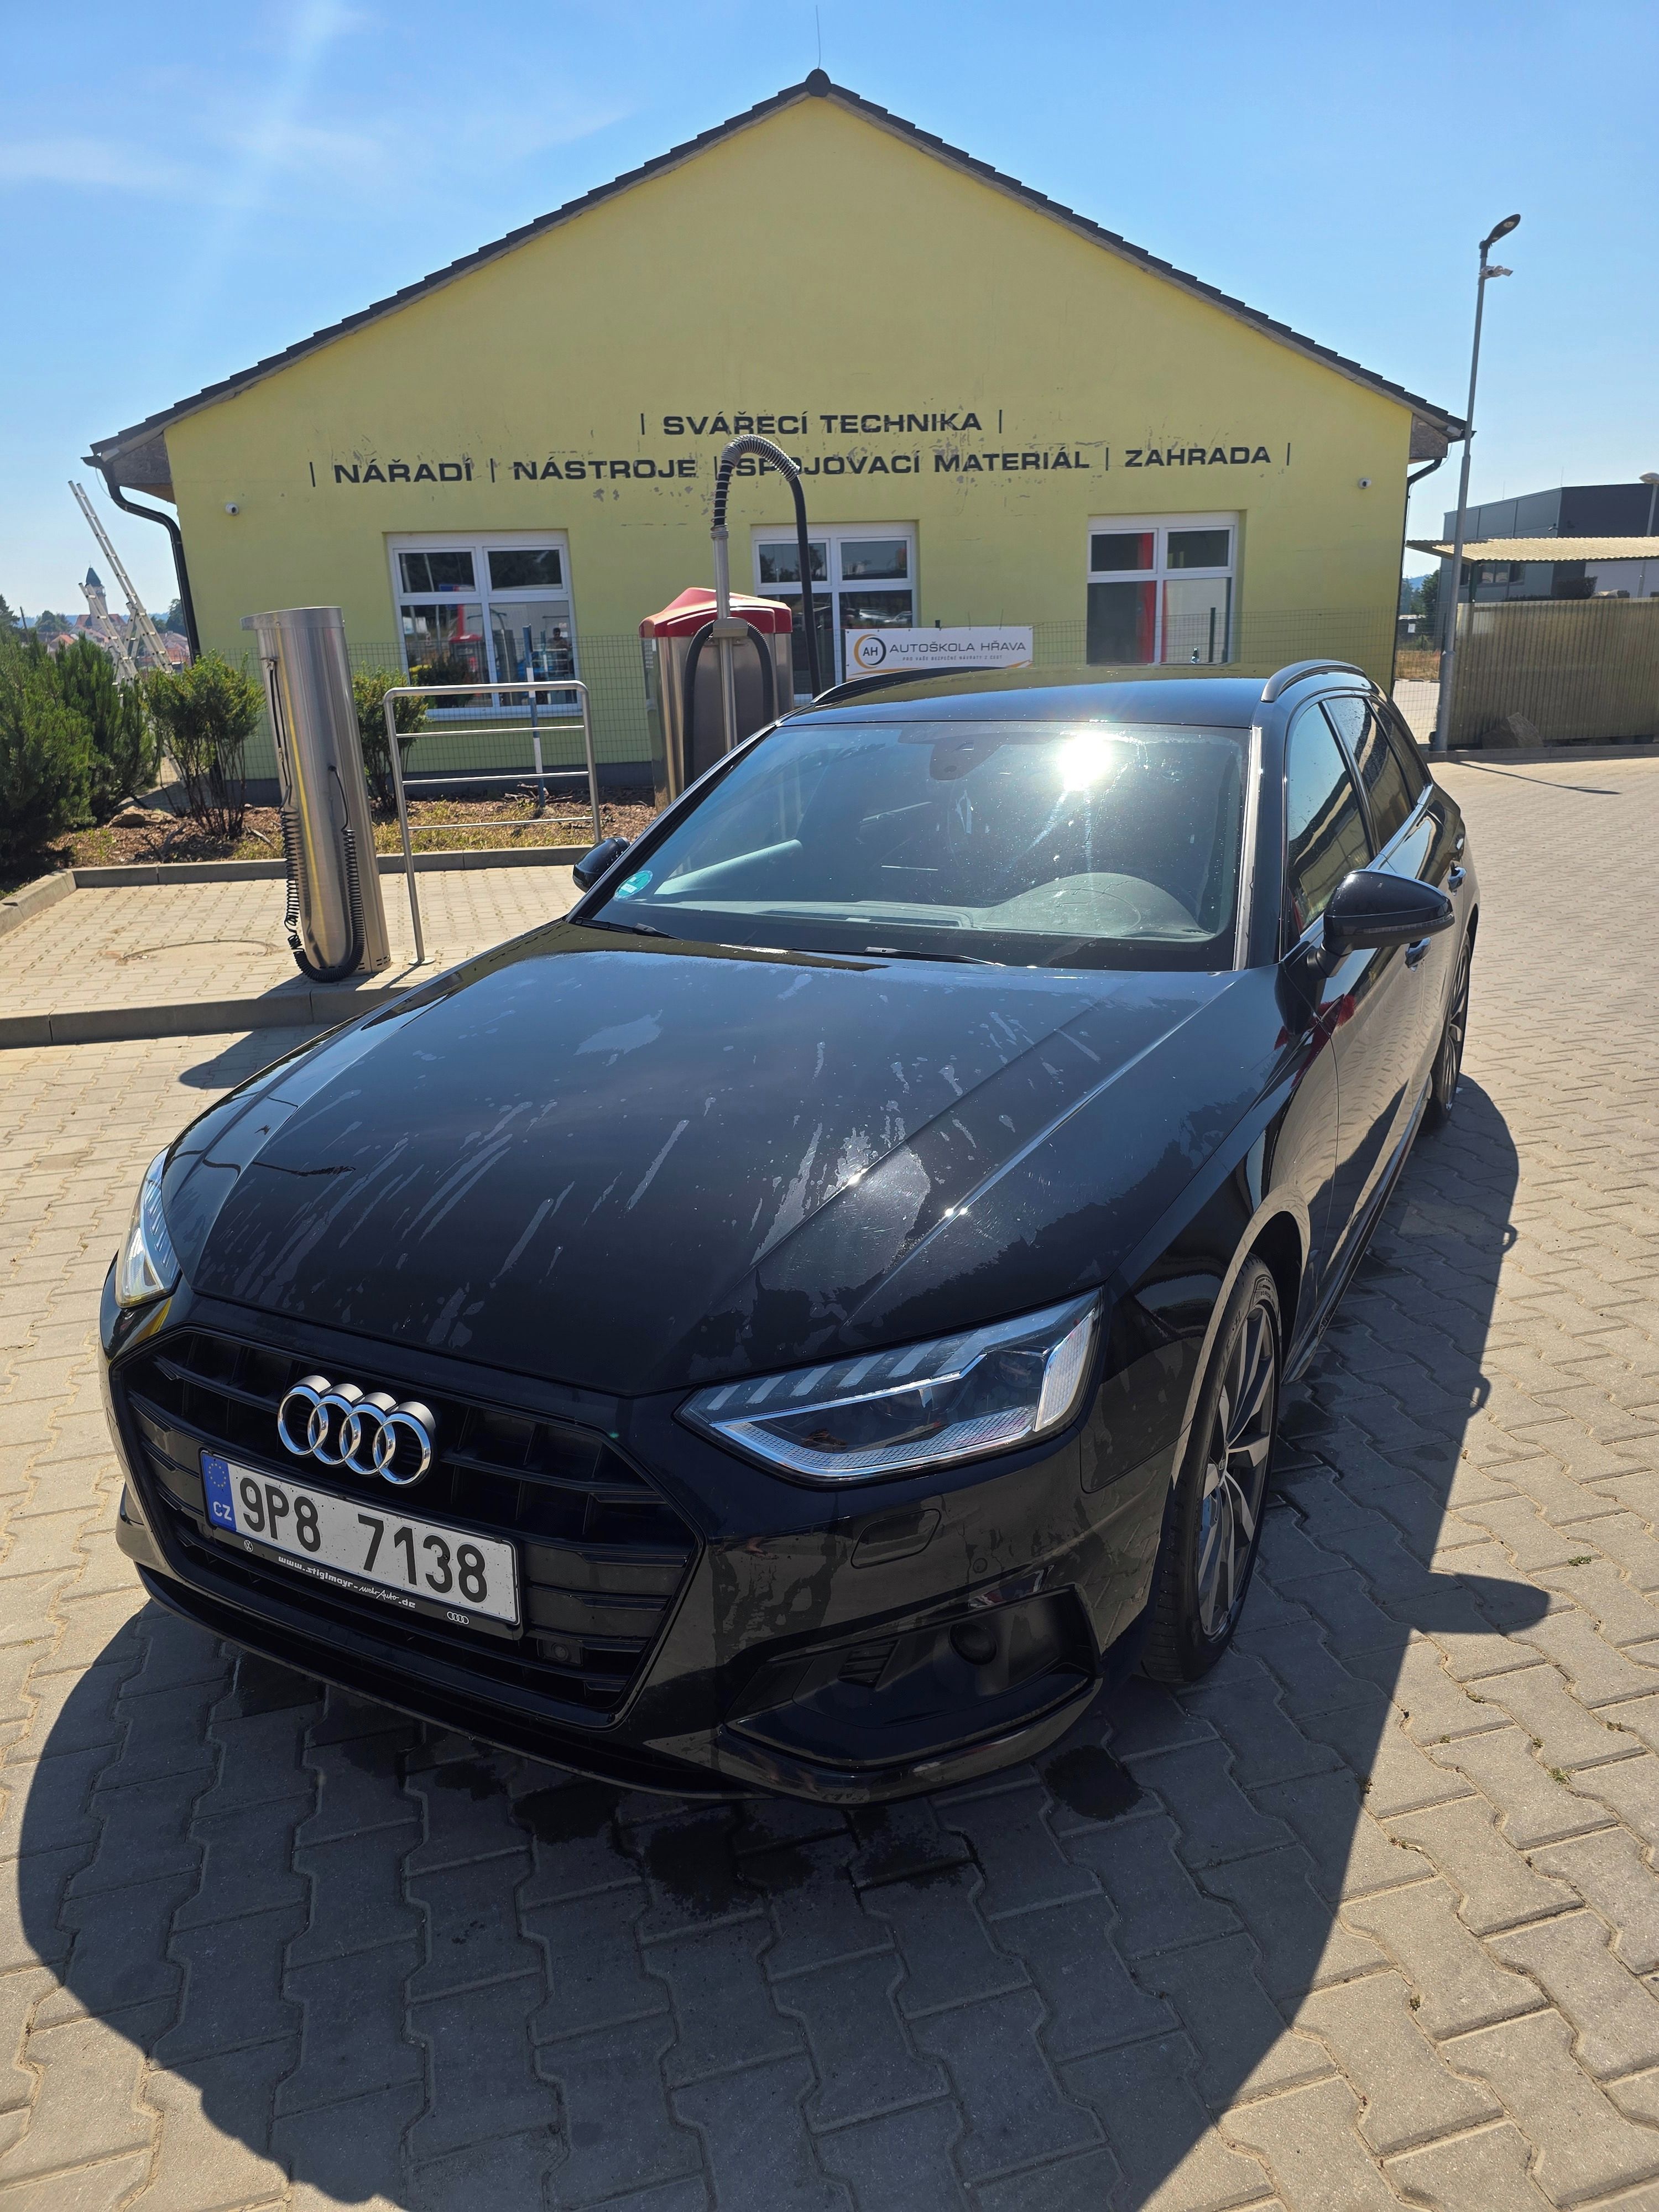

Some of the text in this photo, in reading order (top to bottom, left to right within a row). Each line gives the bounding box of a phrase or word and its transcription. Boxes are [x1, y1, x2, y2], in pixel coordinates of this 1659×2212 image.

[664, 411, 983, 436] SVÁŘECÍ TECHNIKA
[334, 458, 472, 483] NÁŘADÍ
[513, 458, 697, 480] NÁSTROJE
[935, 446, 1089, 472] MATERIÁL
[1124, 446, 1271, 467] ZAHRADA
[863, 647, 878, 656] AH
[889, 640, 1026, 653] AUTOŠKOLA HŘAVA
[213, 1501, 232, 1521] CZ
[240, 1477, 488, 1603] 9P8 7138
